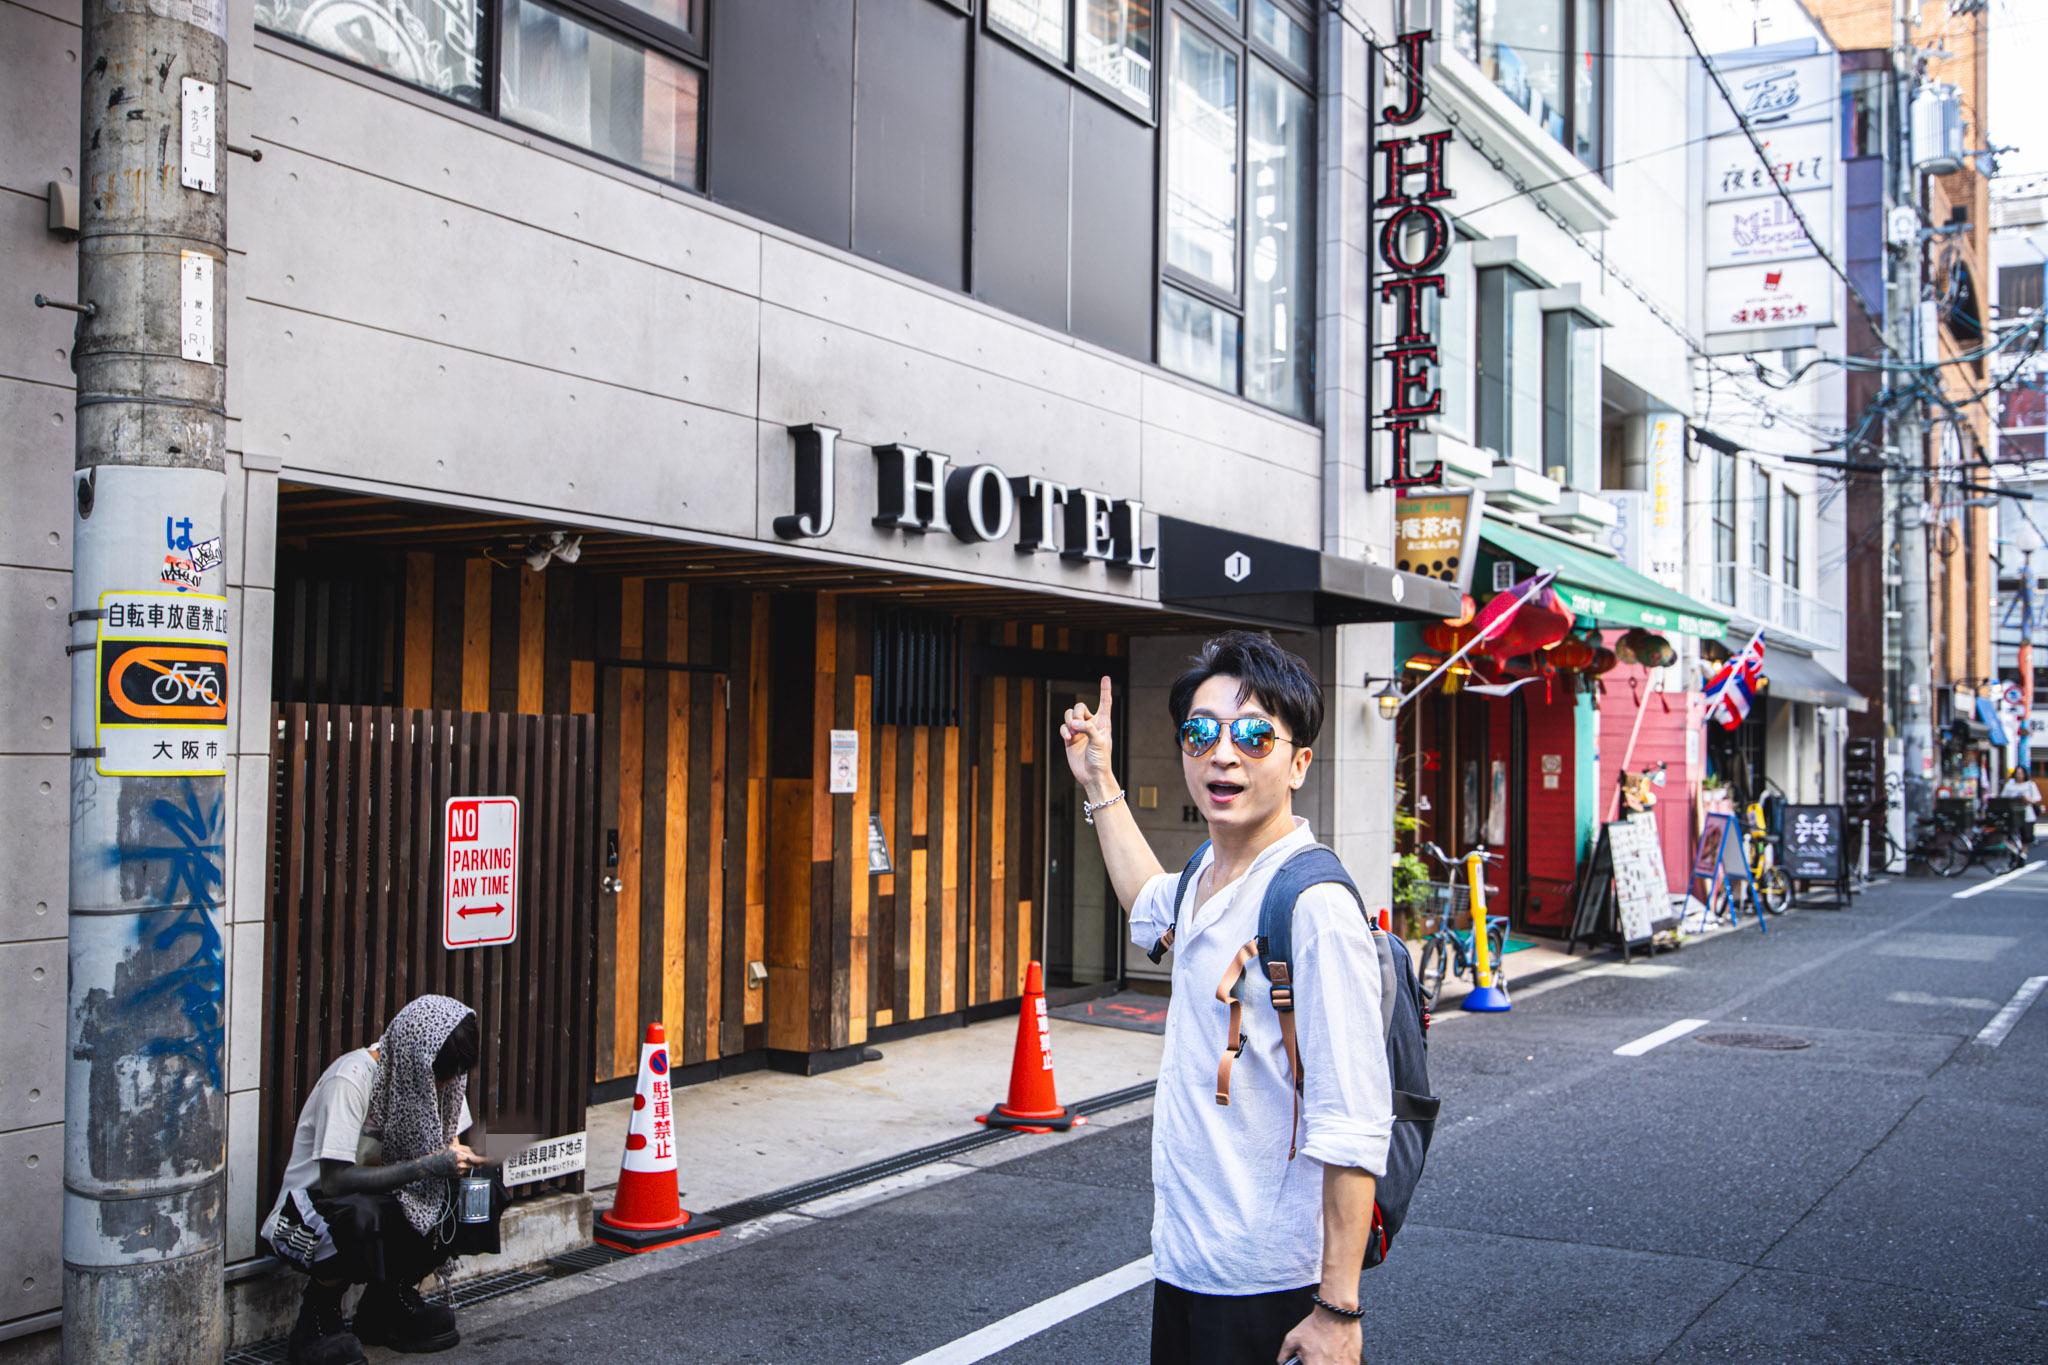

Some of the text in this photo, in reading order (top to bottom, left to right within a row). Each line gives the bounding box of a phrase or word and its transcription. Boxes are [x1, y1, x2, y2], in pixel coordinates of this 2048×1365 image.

[1382, 29, 1432, 126] J
[1376, 129, 1456, 489] HOTEL
[772, 422, 1156, 570] J HOTEL
[152, 740, 218, 760] 大阪市
[452, 808, 476, 838] NO
[452, 875, 509, 898] ANY TIME
[453, 847, 511, 872] PARKING
[653, 1080, 672, 1160] 駐車禁止
